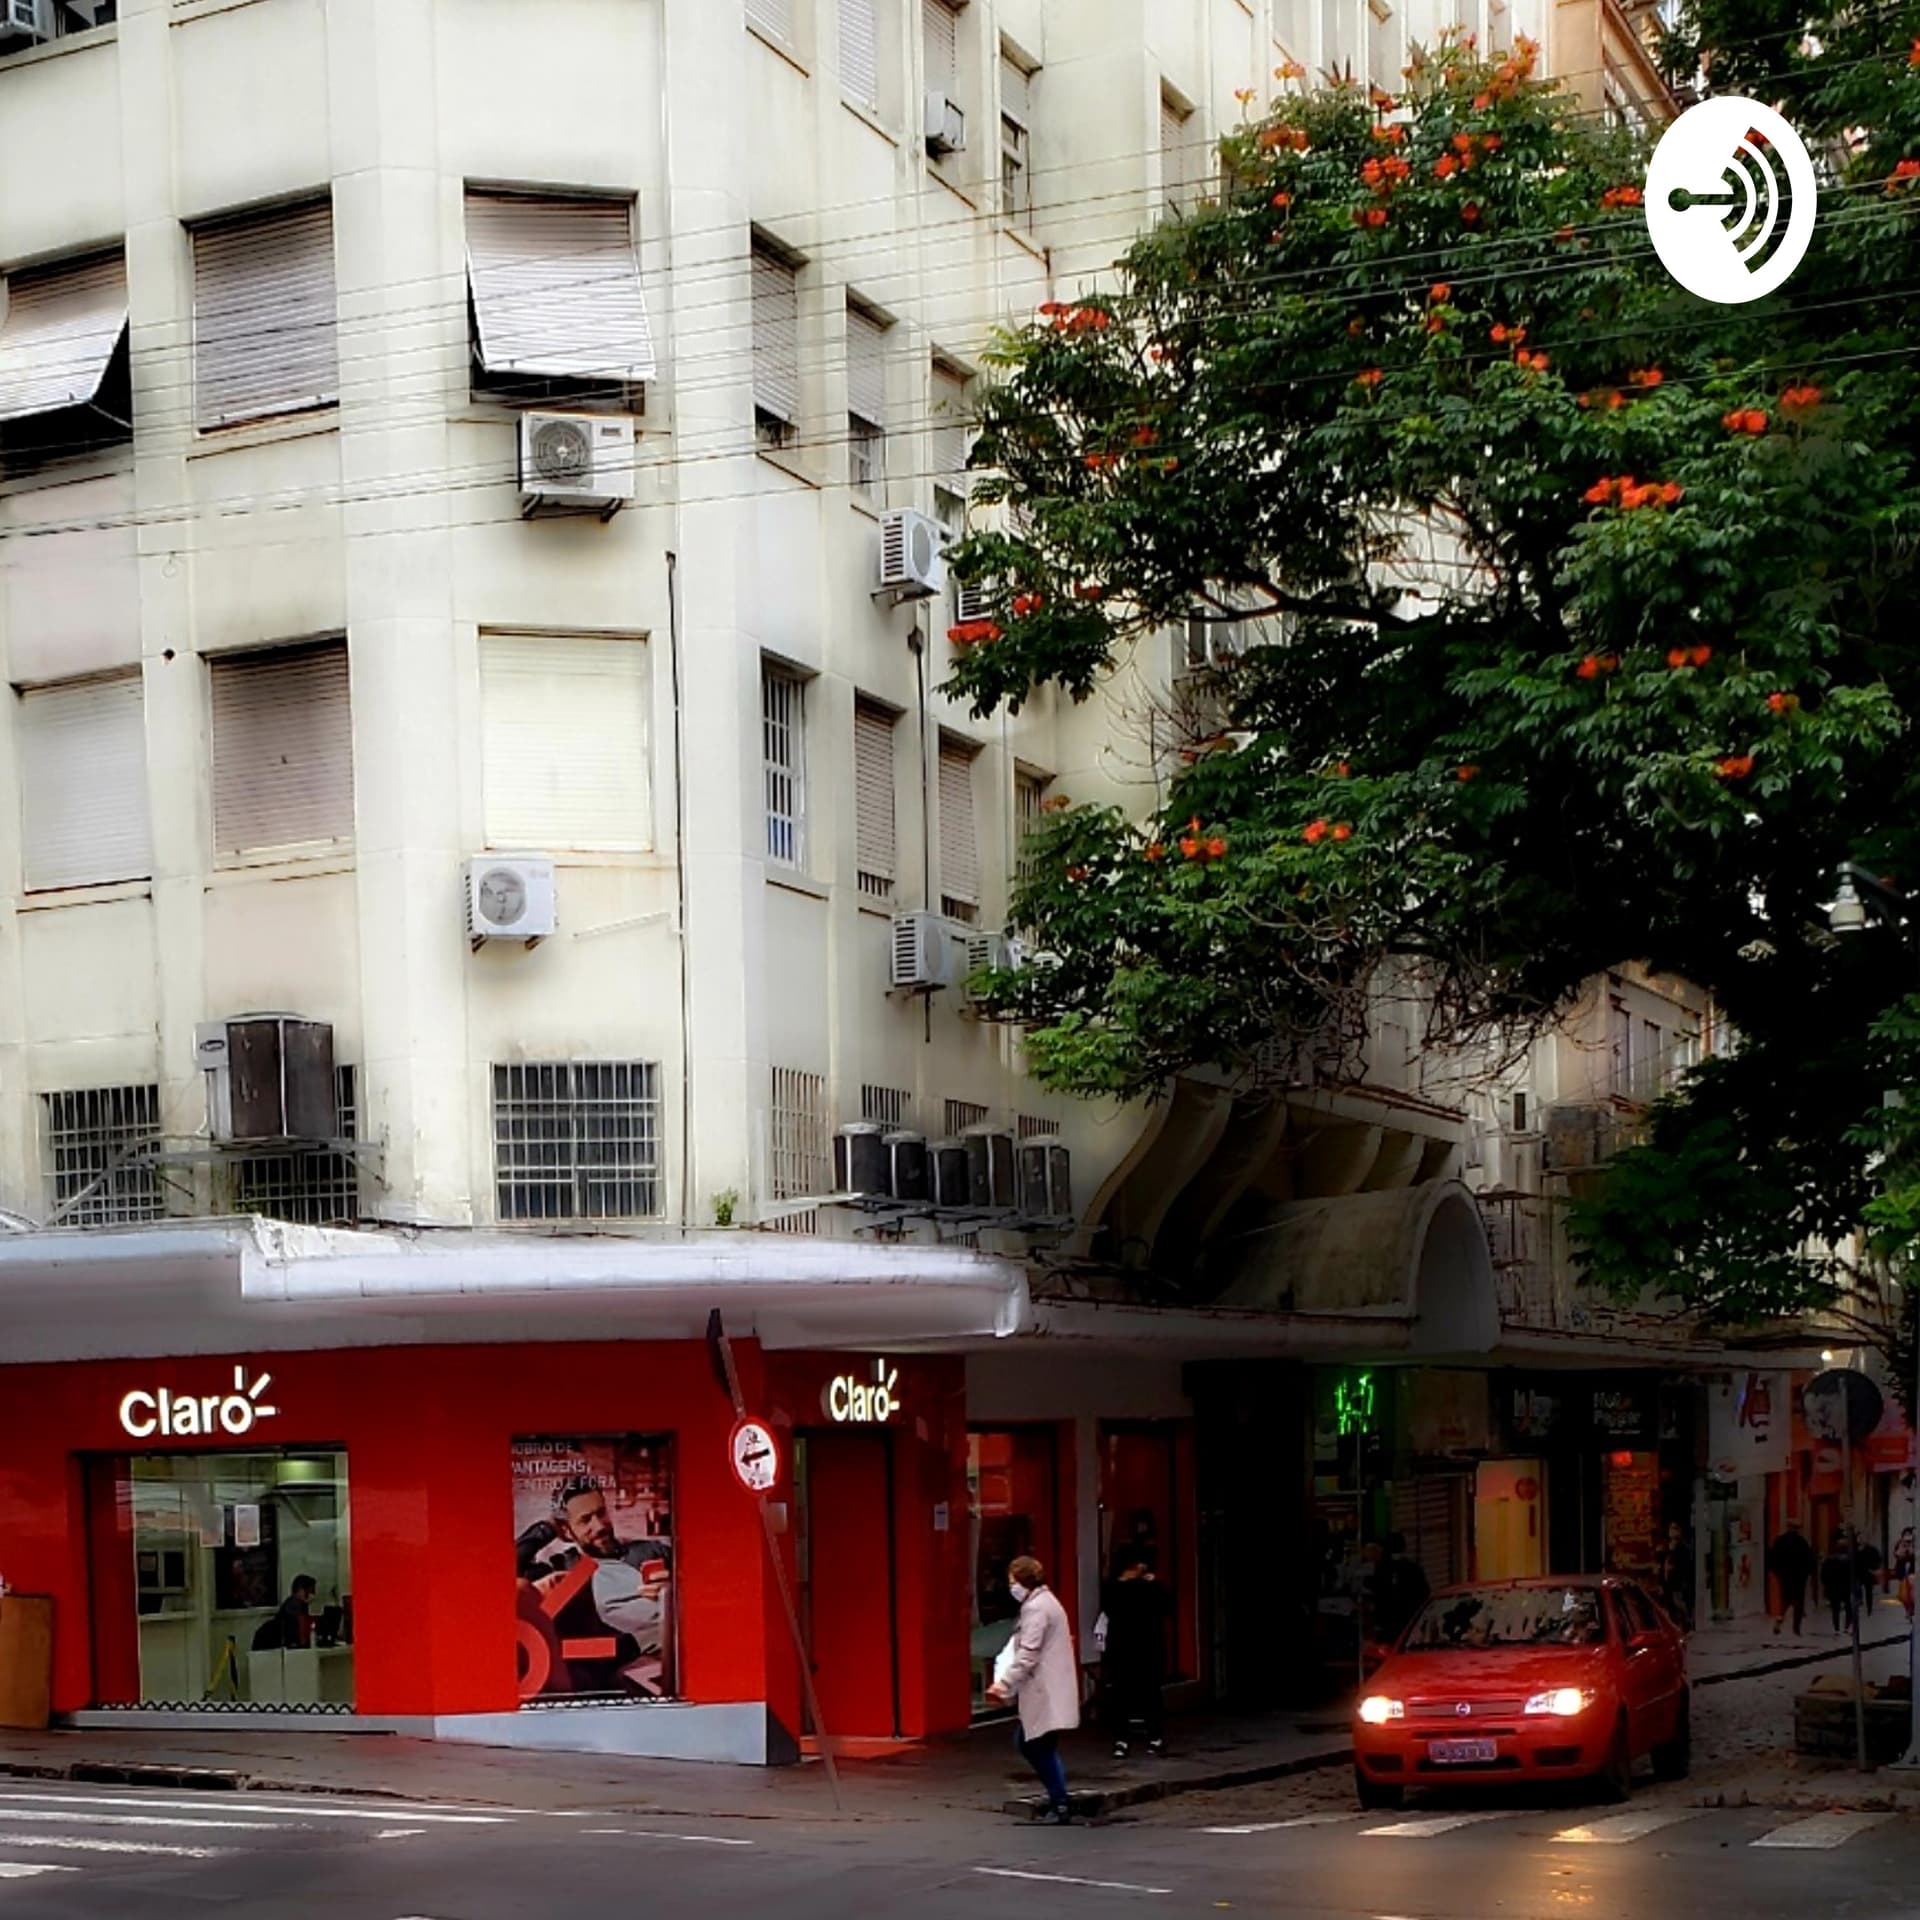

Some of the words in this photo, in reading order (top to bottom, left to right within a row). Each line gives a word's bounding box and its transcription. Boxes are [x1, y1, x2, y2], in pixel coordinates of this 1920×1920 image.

[119, 1386, 253, 1438] Claro
[829, 1375, 890, 1422] Claro
[514, 1477, 564, 1491] ENTRO
